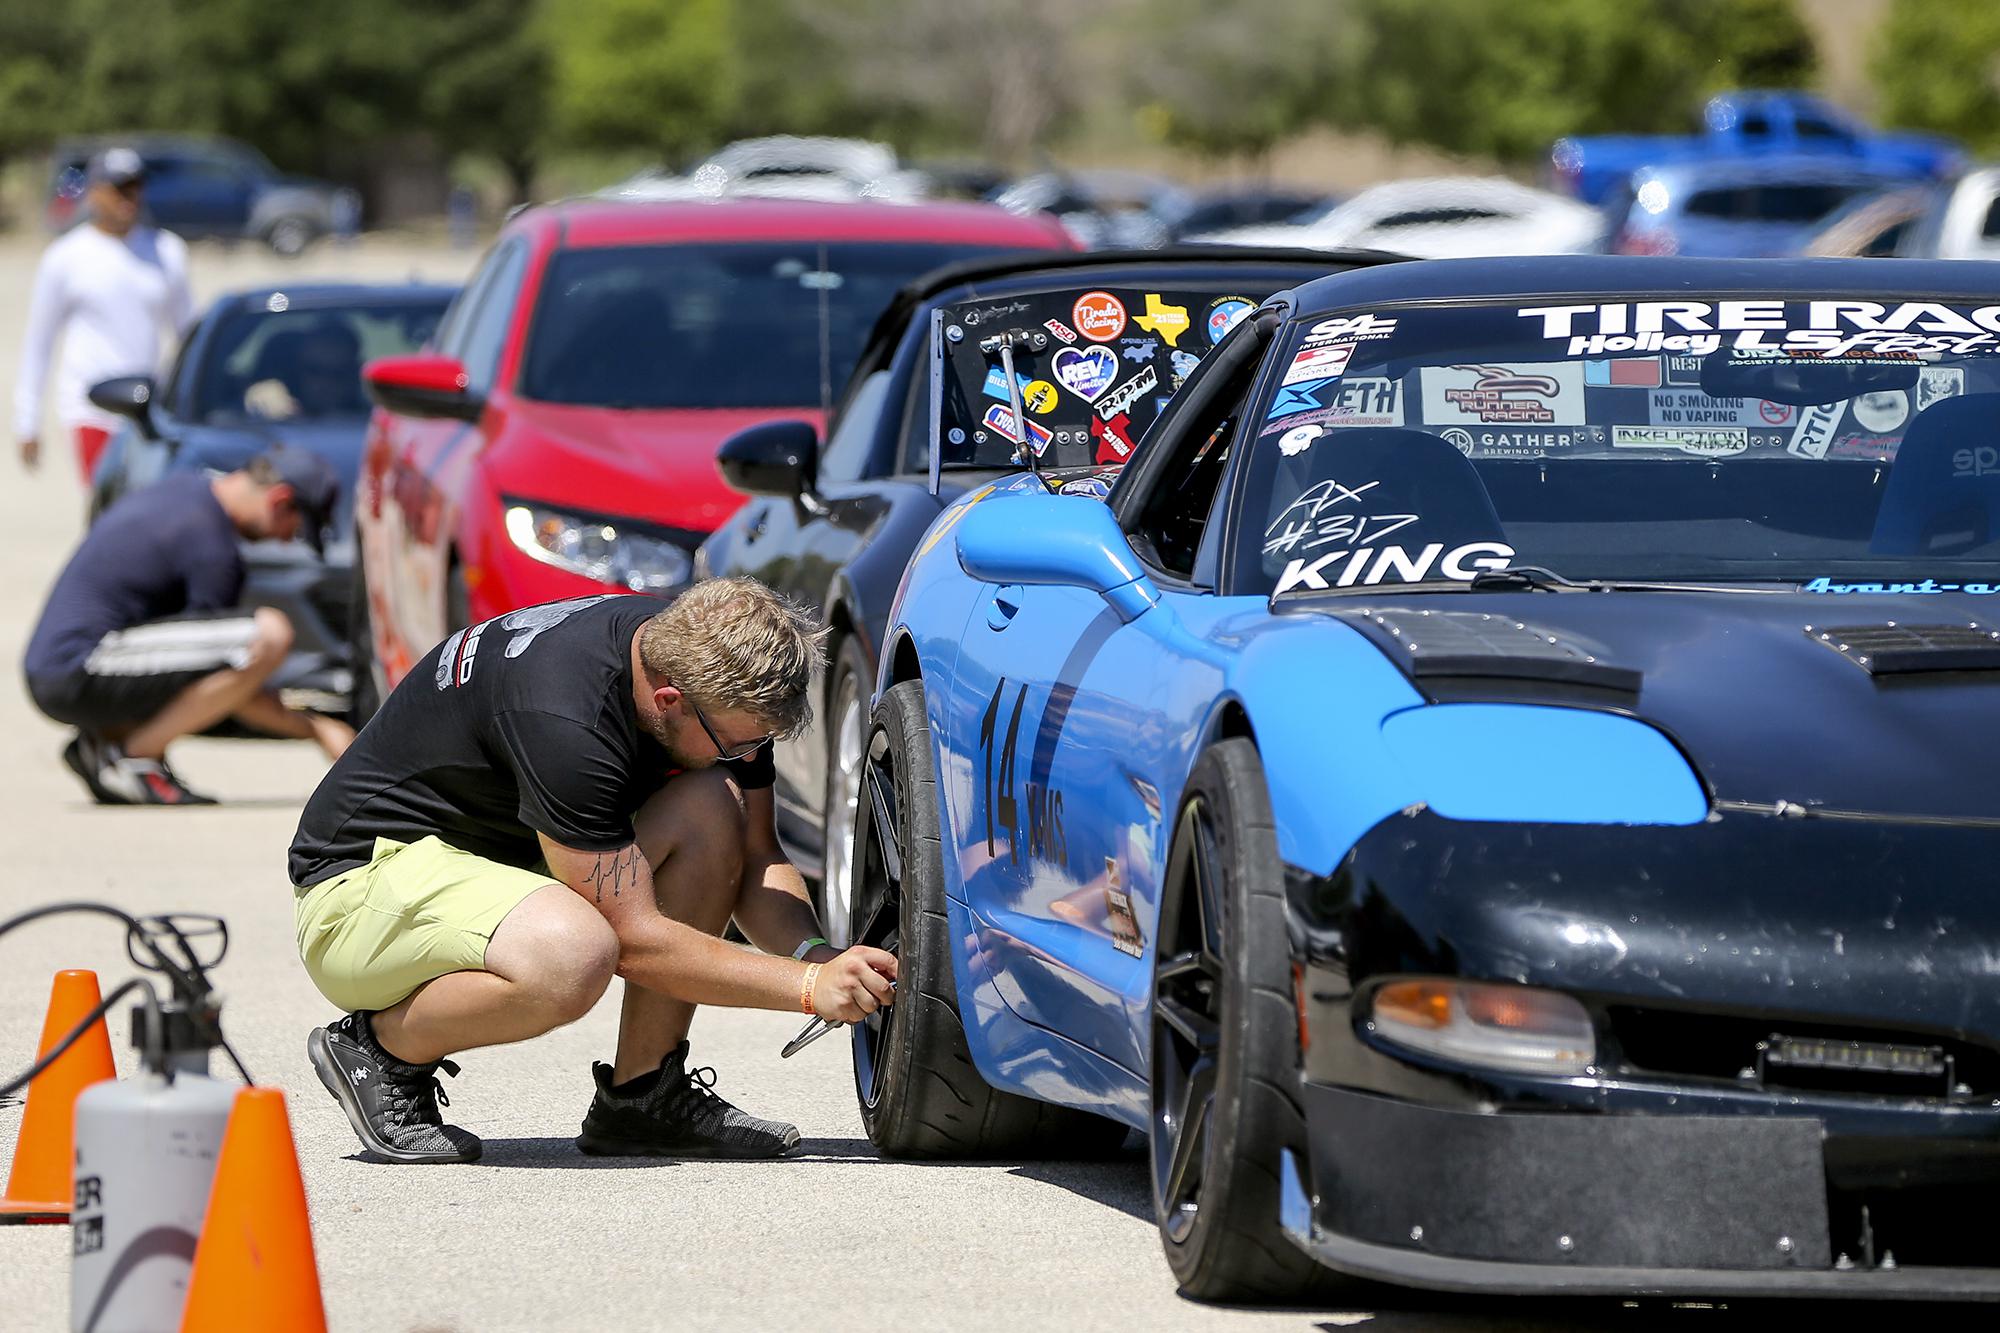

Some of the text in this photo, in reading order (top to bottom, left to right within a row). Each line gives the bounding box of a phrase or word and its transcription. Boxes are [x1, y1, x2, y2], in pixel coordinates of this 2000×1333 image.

[1079, 302, 1118, 318] Tirado
[1083, 316, 1120, 331] Racing
[1517, 300, 1787, 339] TIRE
[1047, 320, 1076, 341] MSD
[1299, 332, 1391, 351] INTERNATIONAL
[1567, 331, 1722, 356] Holley
[1061, 352, 1106, 383] REV
[1727, 359, 1776, 367] SOCIETY
[1867, 358, 1929, 367] ENGINEERS
[1096, 367, 1156, 417] RPM
[1445, 390, 1501, 402] ROAD
[1460, 400, 1541, 412] RUNNER
[1654, 394, 1744, 409] NO SMOKING
[1481, 410, 1554, 422] RACING
[1662, 410, 1738, 423] NO VAPING
[1481, 433, 1571, 447] GATHER
[1261, 513, 1421, 555] #317
[1271, 541, 1517, 597] KING
[979, 676, 1029, 865] 14
